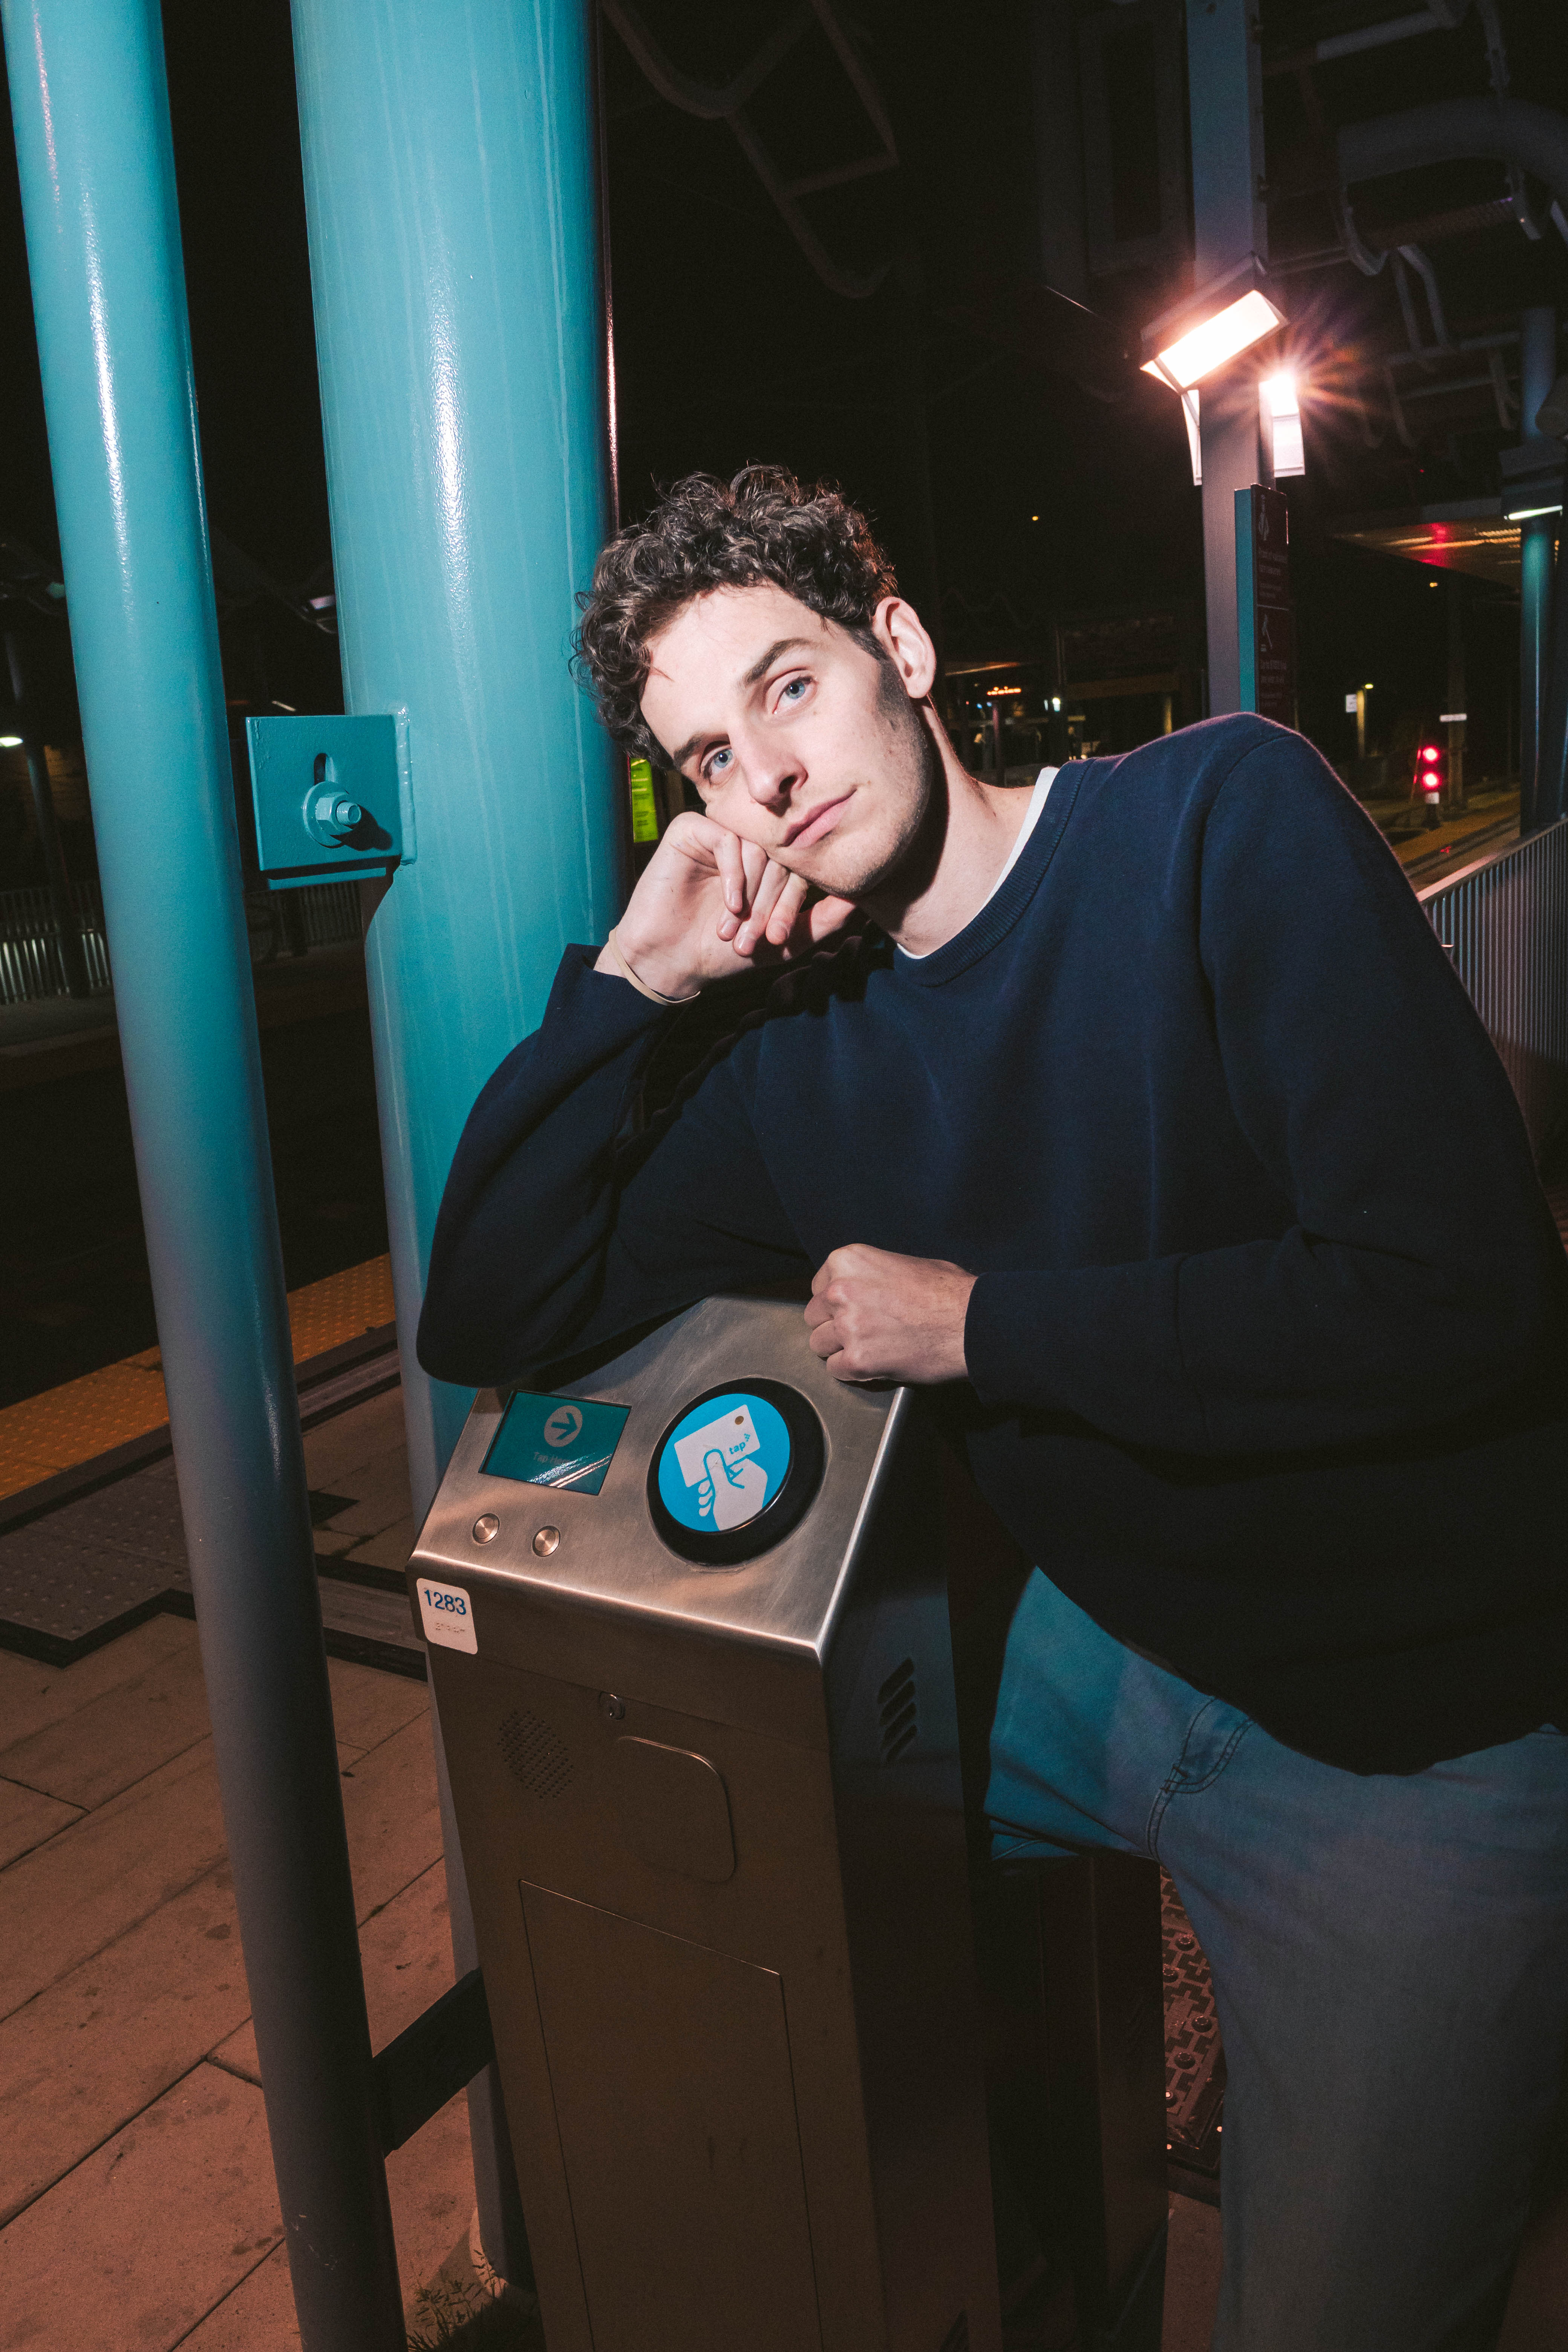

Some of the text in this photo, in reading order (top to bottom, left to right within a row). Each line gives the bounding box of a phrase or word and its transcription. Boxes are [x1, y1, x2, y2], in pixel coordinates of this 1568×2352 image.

[729, 1442, 746, 1455] tap
[533, 1452, 548, 1463] Tap
[424, 1589, 467, 1615] 1283
